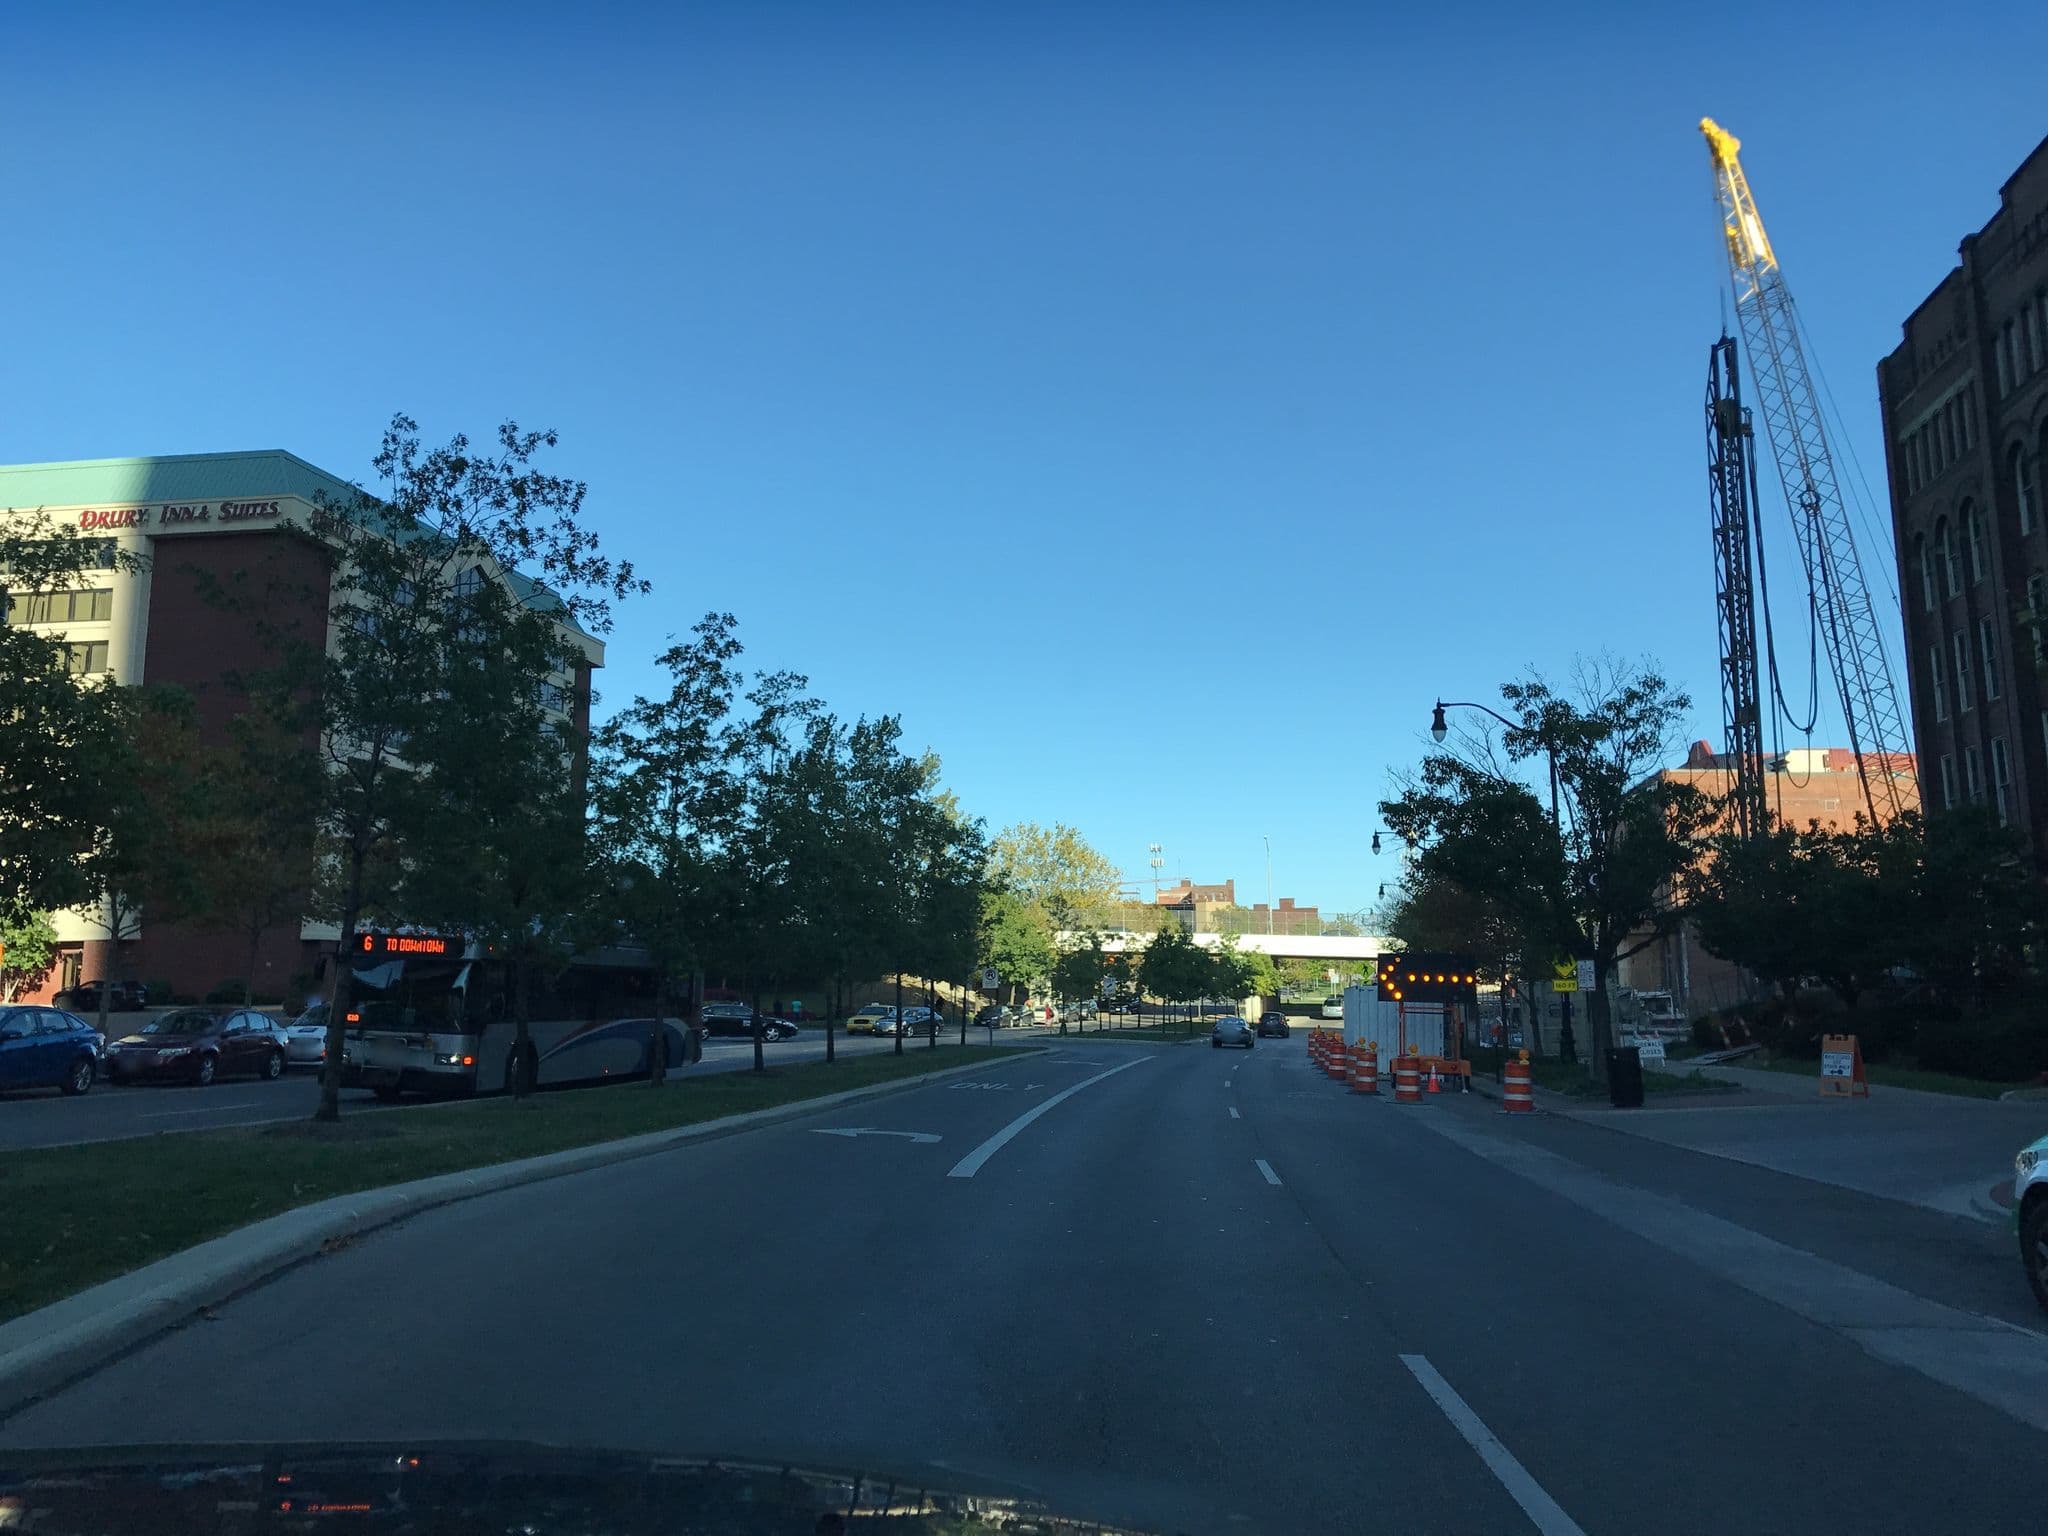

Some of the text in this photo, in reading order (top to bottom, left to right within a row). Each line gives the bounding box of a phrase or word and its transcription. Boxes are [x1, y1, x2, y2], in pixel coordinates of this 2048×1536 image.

[80, 509, 147, 530] DRURY
[218, 502, 279, 521] SUITES
[363, 935, 446, 954] 6 TO DOWNTOWN
[948, 1082, 1045, 1091] ONLY
